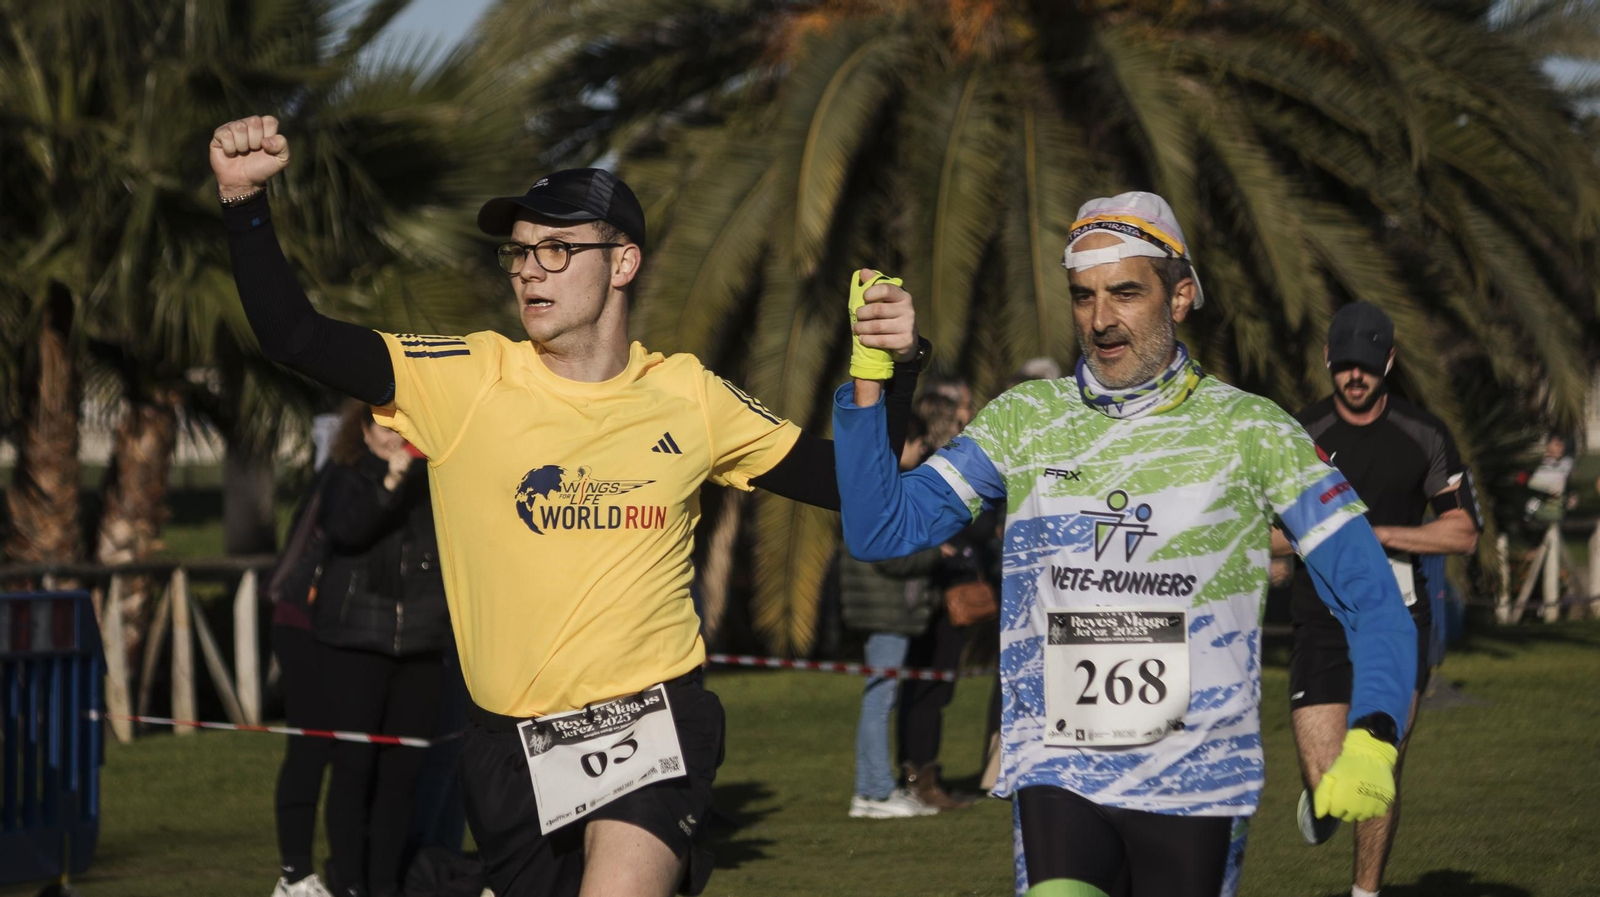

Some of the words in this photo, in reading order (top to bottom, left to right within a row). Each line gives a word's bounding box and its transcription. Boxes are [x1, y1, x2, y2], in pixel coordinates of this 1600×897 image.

[1069, 223, 1099, 240] TRAIL
[1101, 222, 1142, 238] PIRATA
[1043, 468, 1082, 481] FRX
[562, 479, 620, 494] WINGS
[570, 493, 603, 505] LIFE
[540, 505, 622, 530] WORLD
[625, 506, 667, 530] RUN
[1051, 565, 1197, 597] VETE-RUNNERS
[1074, 658, 1168, 705] 268
[561, 725, 595, 738] Jerez
[600, 713, 632, 729] 2025
